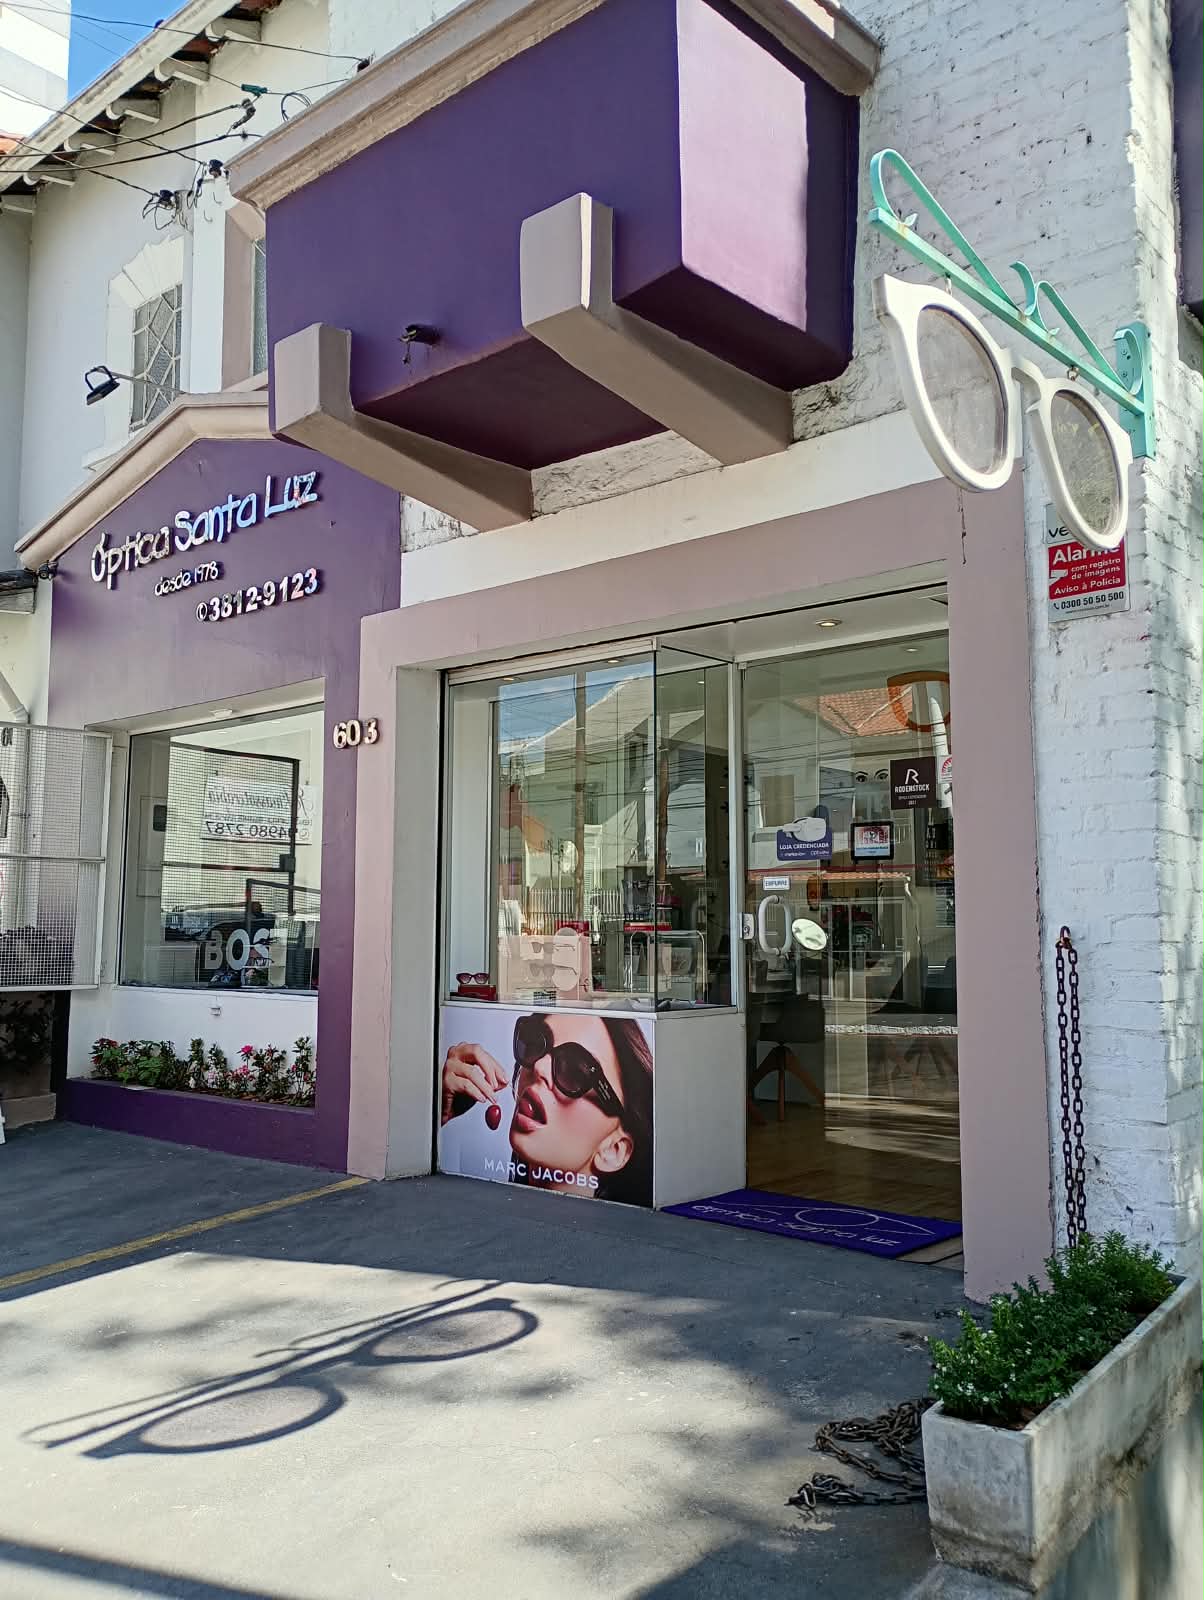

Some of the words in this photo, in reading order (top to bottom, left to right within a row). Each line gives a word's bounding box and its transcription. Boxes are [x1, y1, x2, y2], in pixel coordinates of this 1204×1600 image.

[91, 526, 171, 590] Óptica
[174, 492, 257, 551] Santa
[264, 471, 318, 518] Luz
[1052, 545, 1120, 566] Alar
[1071, 562, 1088, 573] com
[1089, 558, 1121, 570] registro
[154, 568, 192, 596] desde
[193, 561, 220, 584] 1978
[1071, 572, 1082, 580] de
[1084, 566, 1121, 579] imagens
[207, 567, 318, 622] 3812-9123
[1054, 585, 1079, 595] Aviso
[1081, 582, 1088, 590] à
[1090, 576, 1121, 588] Polícia
[1060, 598, 1081, 610] 0300
[1083, 596, 1094, 606] 50
[1095, 594, 1106, 604] 50
[1107, 591, 1124, 601] 500
[333, 718, 378, 749] 603
[894, 783, 930, 793] RODENSTOCK
[793, 842, 830, 850] CREDENCIADA
[484, 1159, 527, 1177] MARC
[532, 1167, 600, 1189] JACOBS
